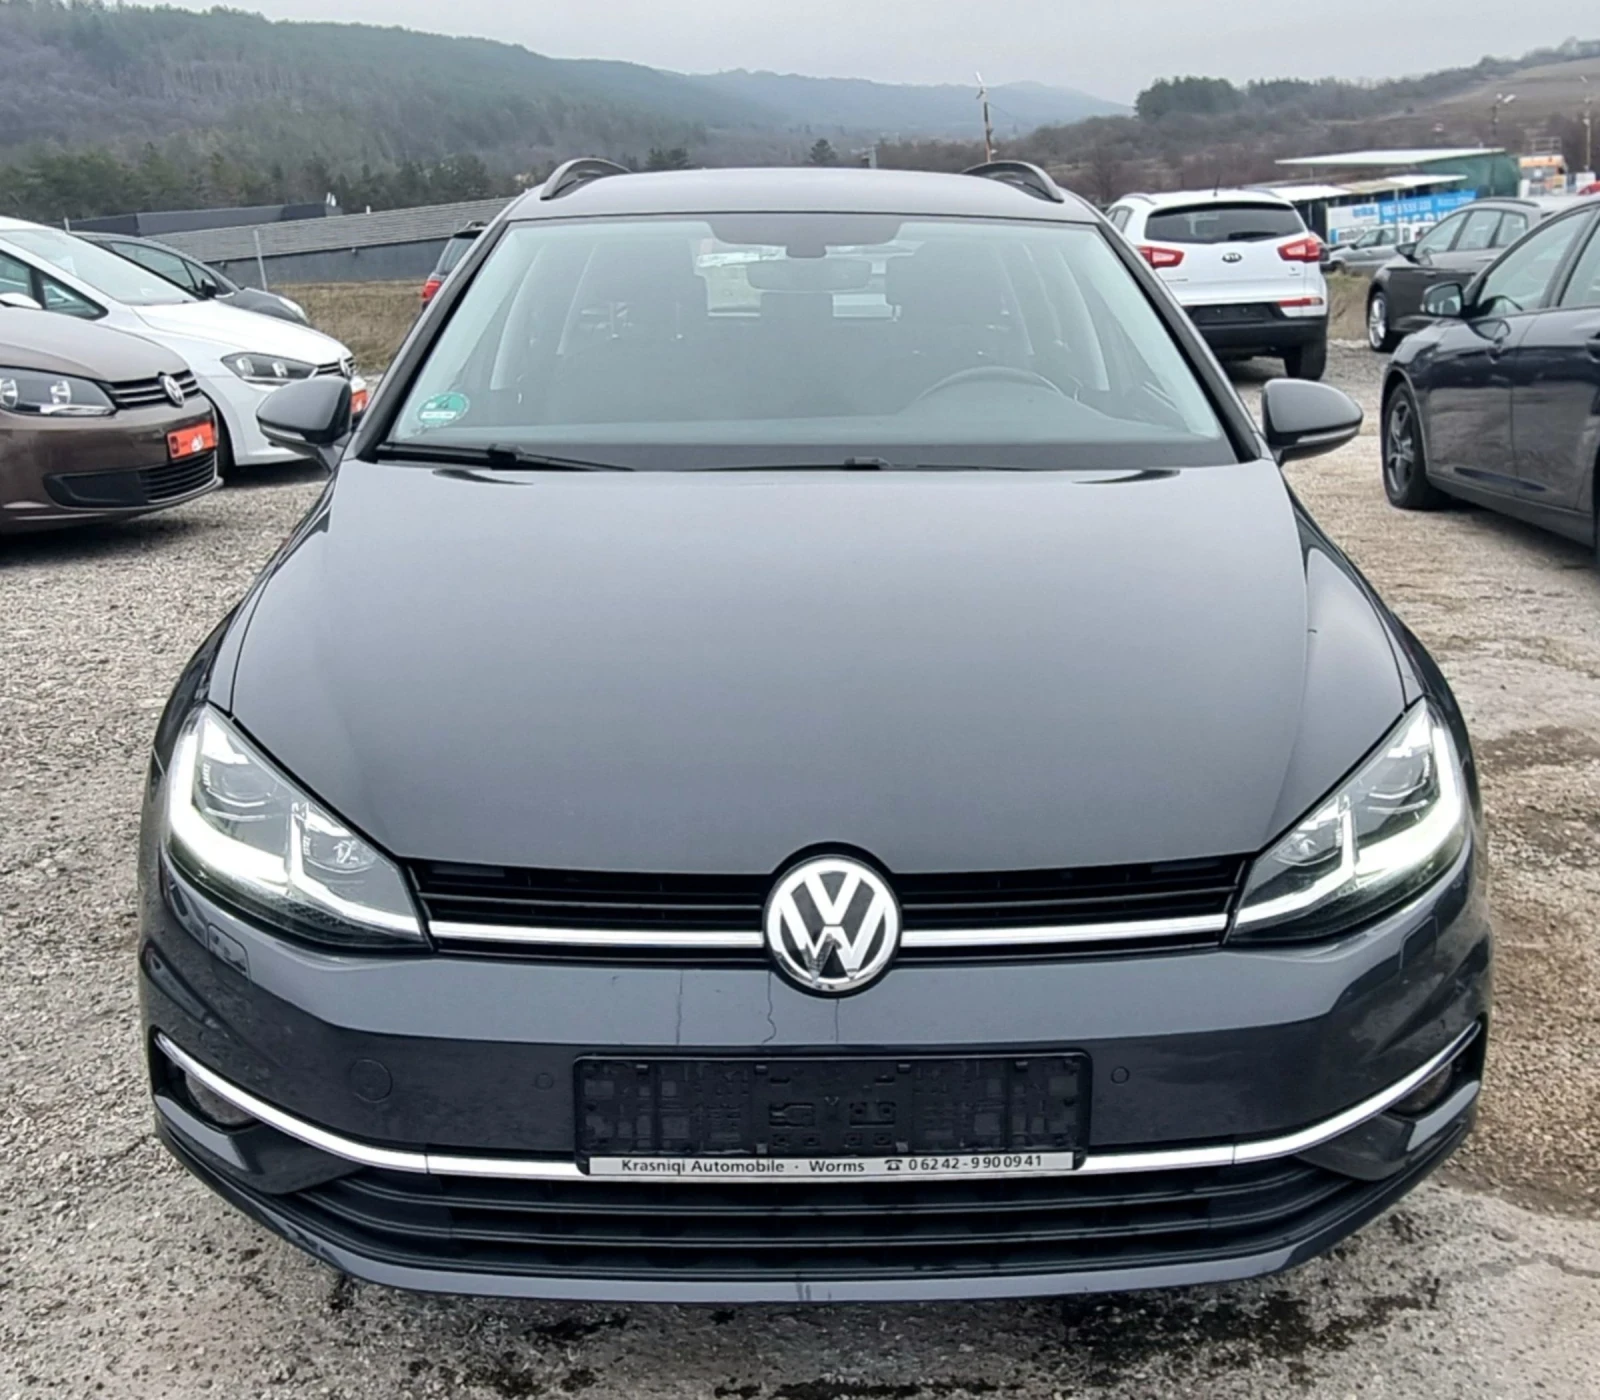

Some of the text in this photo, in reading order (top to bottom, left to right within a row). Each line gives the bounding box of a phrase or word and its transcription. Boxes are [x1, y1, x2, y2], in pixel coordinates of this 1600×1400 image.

[621, 1155, 1042, 1175] Krasniqi Automobile Worms 06242-9900941
